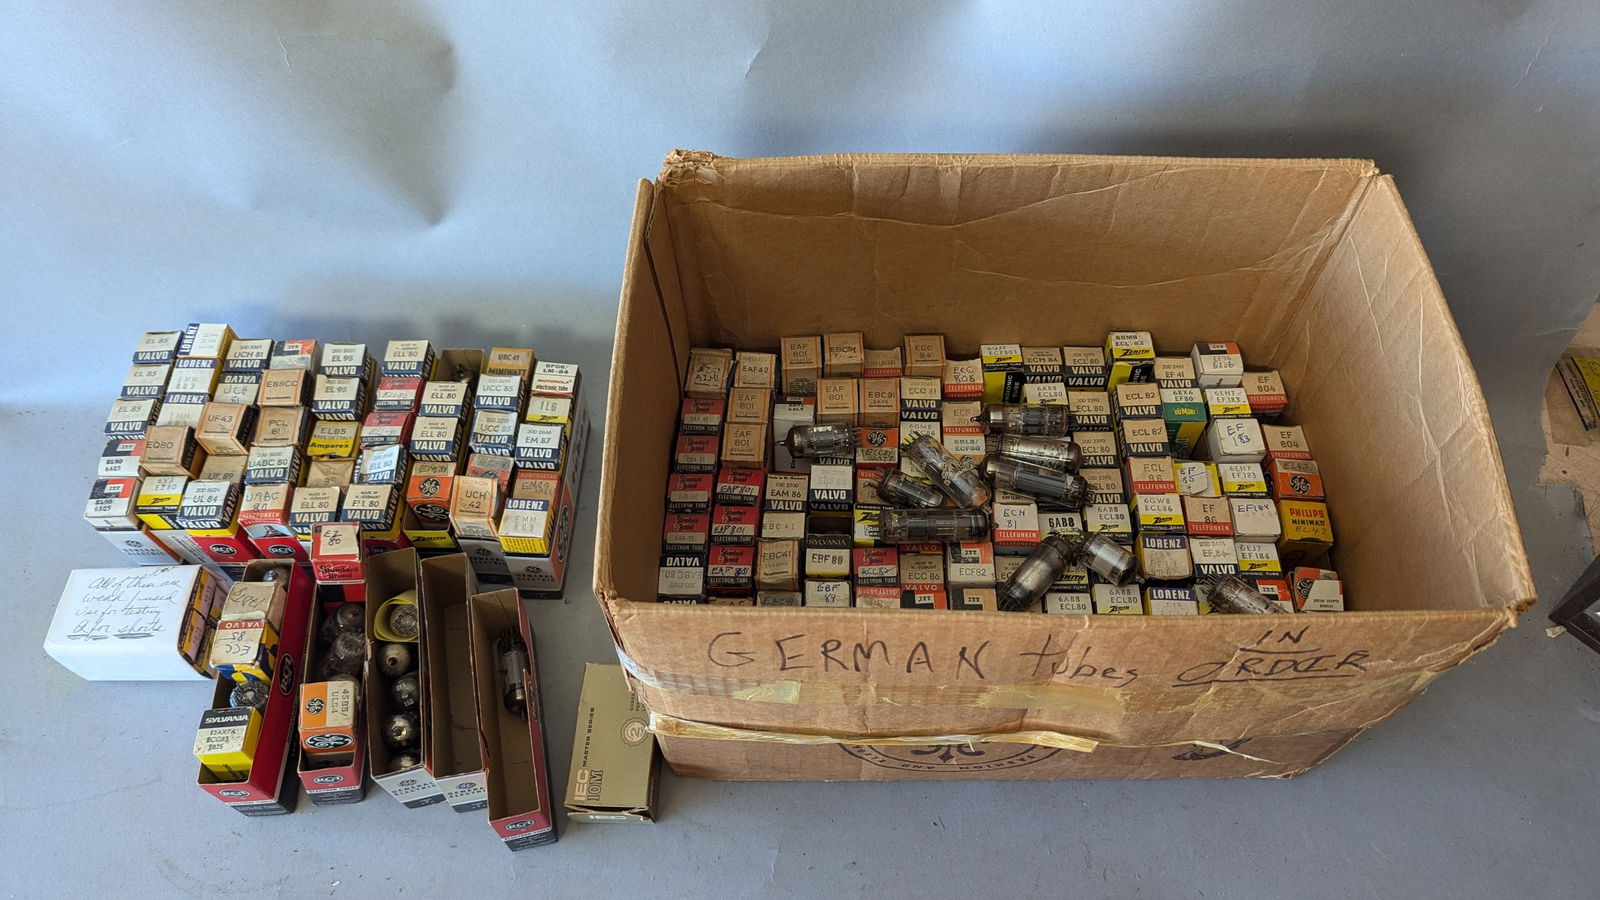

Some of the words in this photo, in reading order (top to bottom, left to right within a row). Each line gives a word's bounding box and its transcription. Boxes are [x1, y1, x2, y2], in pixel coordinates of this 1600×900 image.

[180, 325, 198, 355] LORENZ
[138, 351, 169, 360] VALVO
[1121, 348, 1150, 356] ZENITH
[178, 360, 212, 368] LORENZ
[229, 360, 260, 368] VALVO
[388, 362, 417, 370] VALVO
[325, 366, 356, 375] VALVO
[488, 368, 527, 376] MINIWATT
[1072, 366, 1102, 374] VALVO
[1068, 378, 1105, 386] VALVO
[1161, 380, 1191, 388] VALVO
[127, 386, 158, 395] VALVO
[168, 395, 204, 403] LORENZ
[480, 397, 511, 405] VALVO
[318, 401, 350, 409] VALVO
[905, 400, 936, 408] VALVO
[424, 405, 456, 413] VALVO
[1124, 406, 1156, 415] VALVO
[1076, 415, 1108, 424] VALVO
[110, 422, 142, 431] VALVO
[1227, 423, 1245, 436] EF
[477, 435, 508, 443] VALVO
[1280, 431, 1293, 439] EF
[146, 441, 174, 449] EQ80
[415, 441, 446, 450] VALVO
[1130, 443, 1163, 452] VALVO
[1280, 440, 1299, 449] 804
[520, 448, 552, 458] VALVO
[1143, 463, 1166, 472] ECL
[251, 468, 284, 478] VALVO
[465, 490, 486, 499] UCH
[792, 490, 802, 498] 86
[814, 490, 846, 499] VALVO
[507, 500, 544, 510] LORENZ
[771, 501, 802, 510] VALVO
[1145, 504, 1173, 512] ECL86
[1202, 504, 1216, 513] EF
[184, 507, 216, 516] VALVO
[347, 510, 380, 519] VALVO
[1289, 508, 1324, 518] PHILIPS
[295, 513, 329, 522] VALVO
[1048, 517, 1075, 527] 6AB8
[1291, 519, 1326, 527] MINIWATT
[1145, 538, 1181, 548] LORENZ
[1241, 552, 1270, 560] EF184
[666, 557, 699, 566] VALVO
[959, 567, 987, 576] ECF82
[1201, 564, 1236, 575] VALVO
[908, 572, 928, 580] ECC
[1153, 589, 1190, 599] LORENZ
[1255, 626, 1309, 645] IN
[708, 632, 991, 680] GERMAN
[1020, 634, 1139, 688] tubes
[1176, 649, 1371, 683] ORDER
[281, 658, 292, 691] RCA
[204, 715, 249, 724] SYLVANIA
[574, 769, 589, 800] IEC
[582, 736, 592, 768] MASTER
[588, 770, 604, 801] 10M
